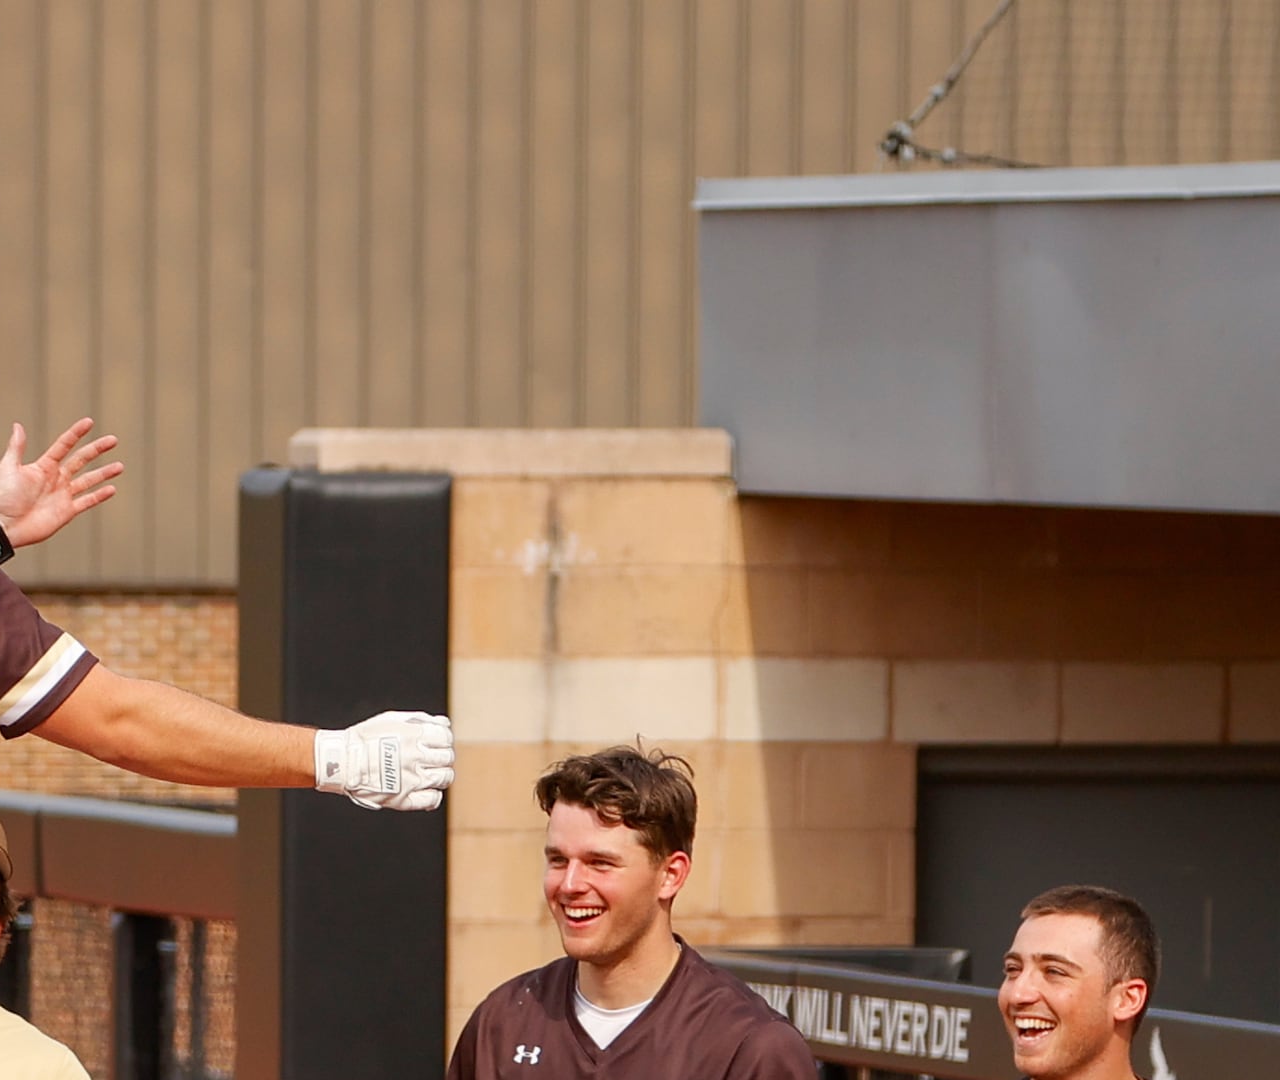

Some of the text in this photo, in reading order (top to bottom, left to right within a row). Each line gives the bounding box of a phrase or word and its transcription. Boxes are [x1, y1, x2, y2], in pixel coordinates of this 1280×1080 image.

[793, 985, 848, 1043] WILL
[850, 994, 928, 1055] NEVER
[929, 1004, 971, 1063] DIE
